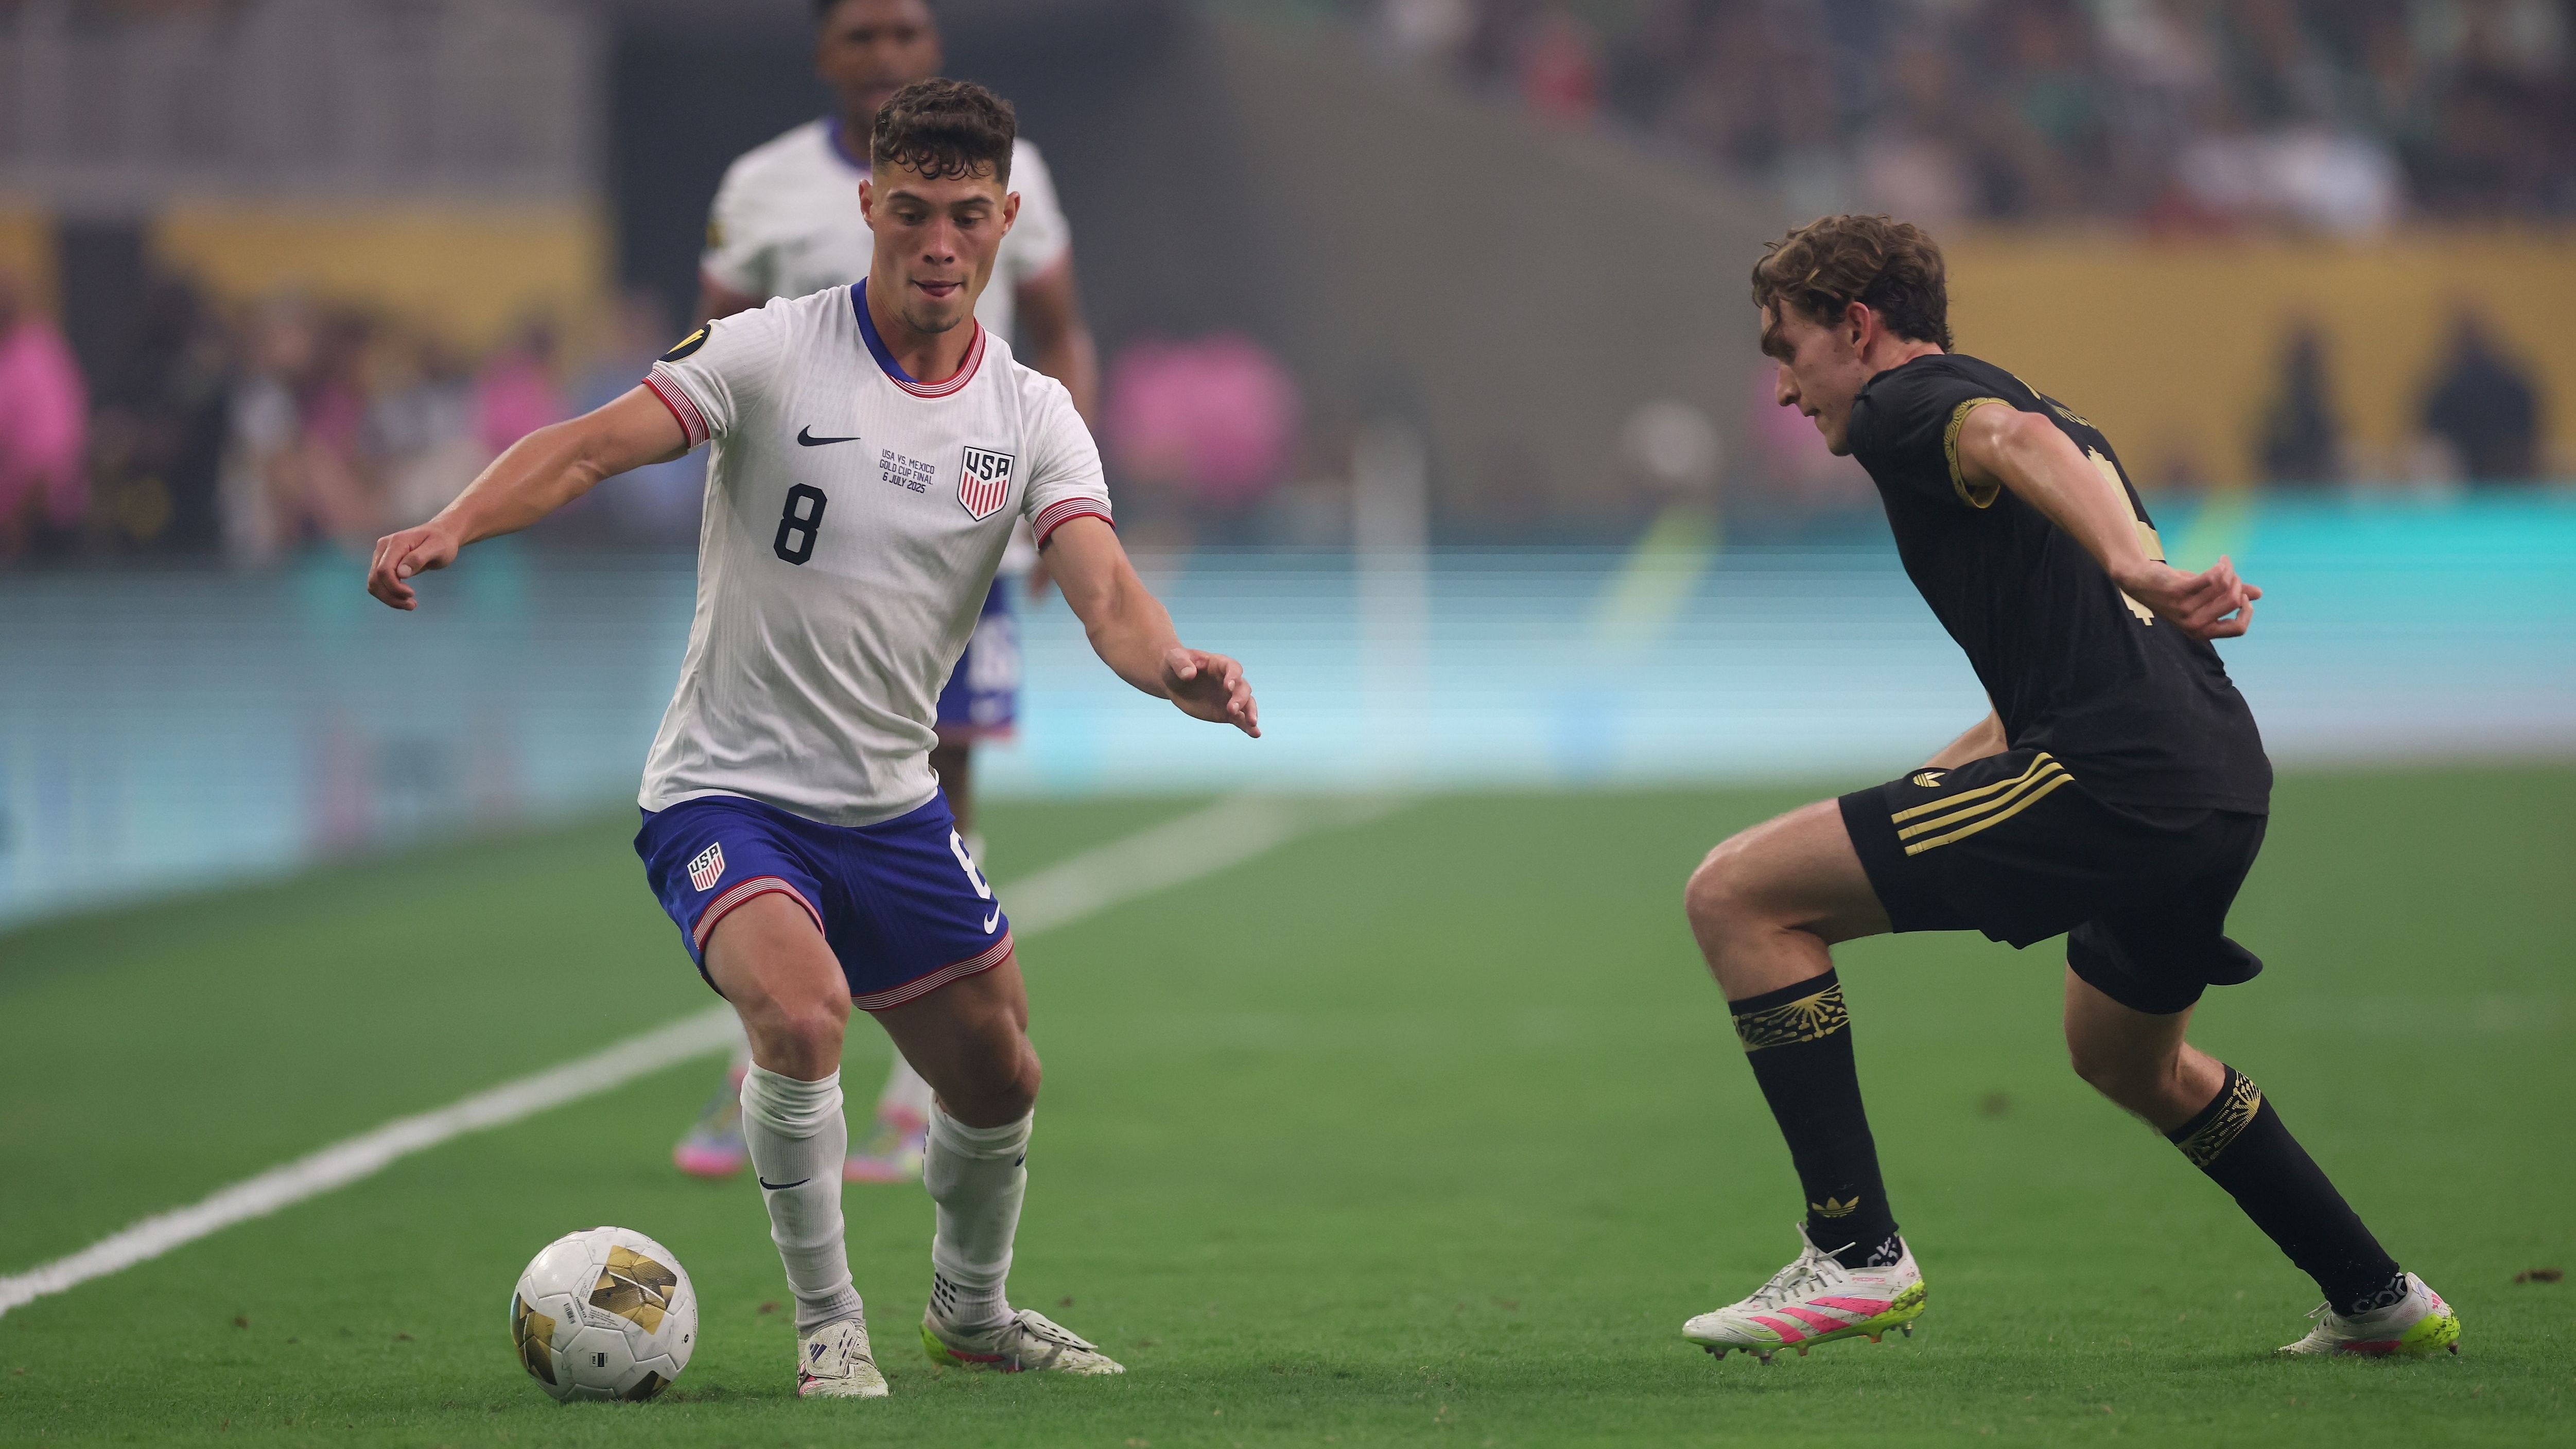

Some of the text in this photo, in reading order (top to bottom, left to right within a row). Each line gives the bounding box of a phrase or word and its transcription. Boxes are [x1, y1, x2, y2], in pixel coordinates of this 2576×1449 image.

[879, 459, 933, 485] GOLD CUP FINAL
[882, 449, 935, 475] USA VS. MEXICO
[966, 451, 1009, 481] USA
[882, 472, 926, 494] 6 JULY 2025
[773, 483, 828, 566] 8
[690, 845, 719, 874] USA
